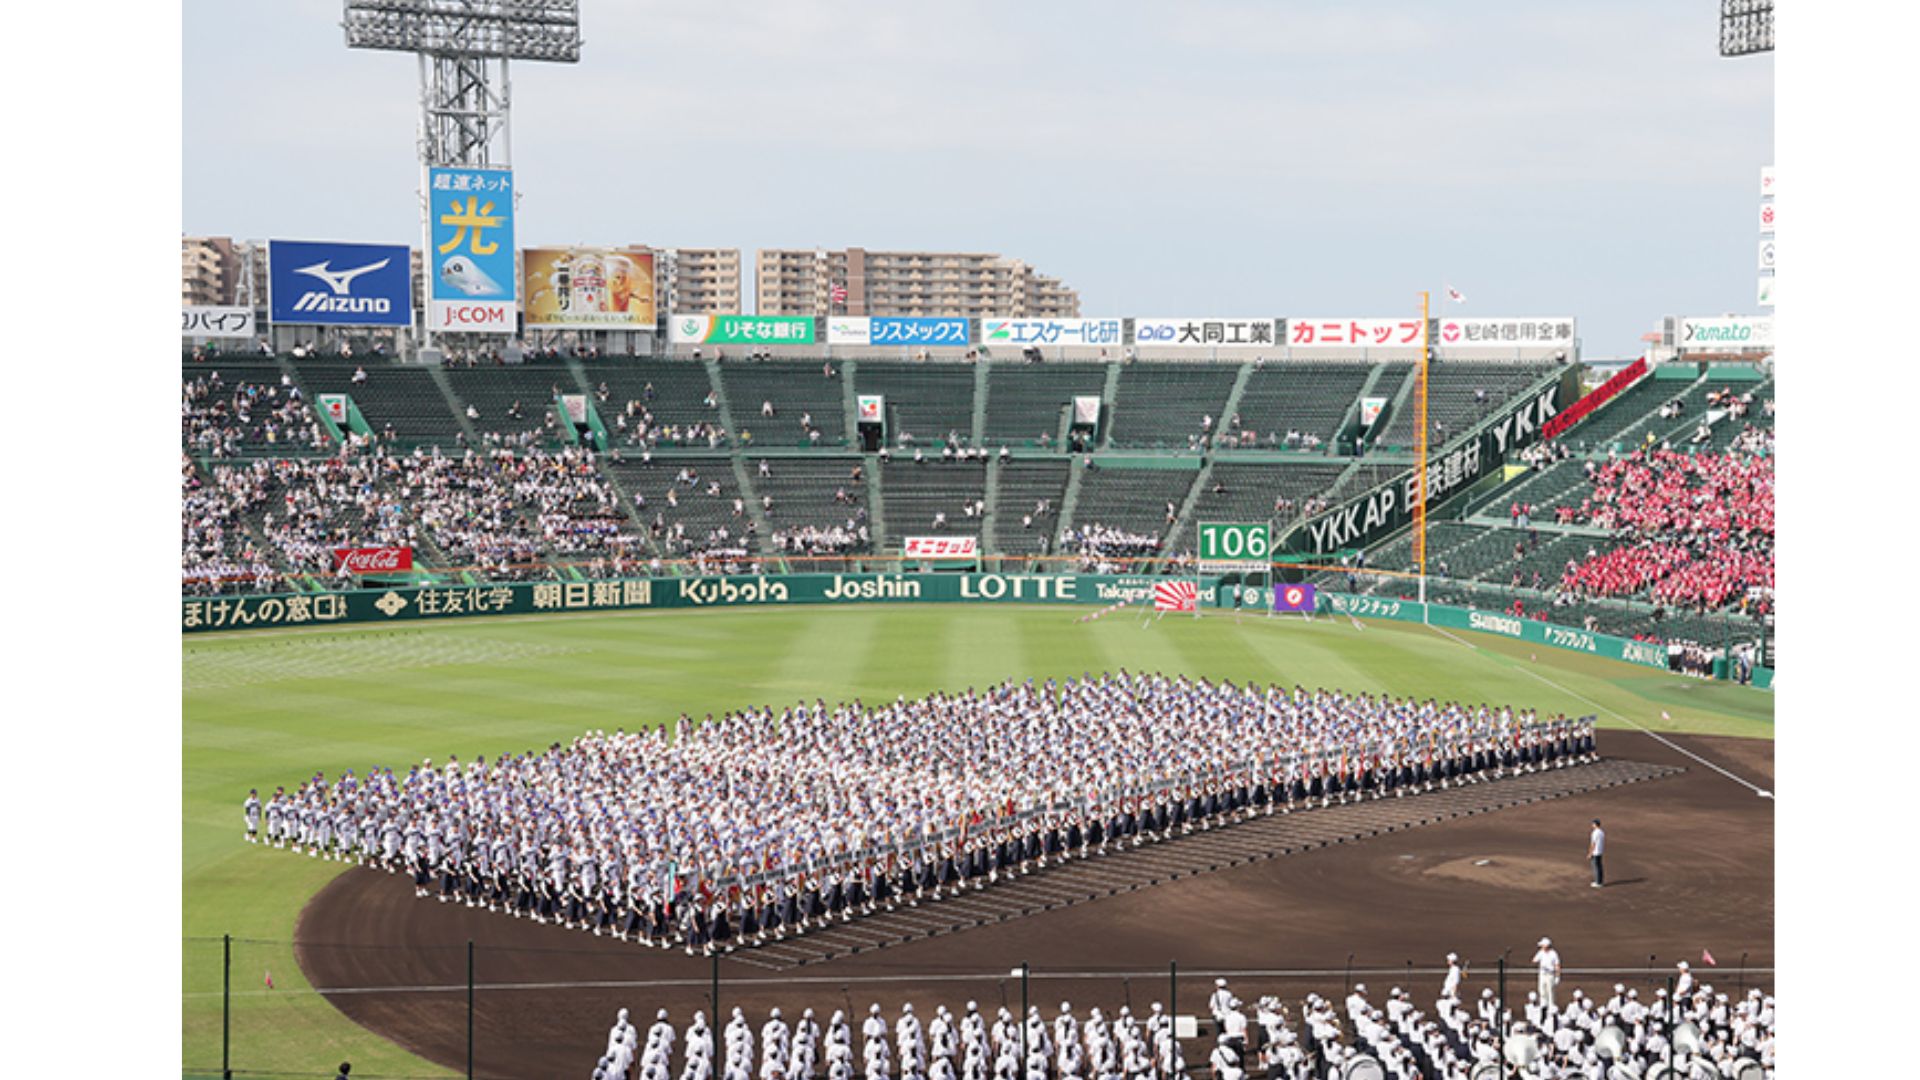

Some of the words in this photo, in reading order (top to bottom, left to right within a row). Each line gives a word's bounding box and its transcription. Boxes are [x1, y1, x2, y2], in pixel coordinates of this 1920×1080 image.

[433, 174, 509, 191] 超速ネット
[439, 195, 508, 255] 光
[293, 292, 390, 313] MIZUNO
[445, 306, 504, 326] J:COM
[725, 322, 806, 339] りそな銀行
[872, 321, 966, 341] シスメックス
[1011, 320, 1119, 343] エスケー化研
[1179, 321, 1273, 344] 大同工業
[1292, 320, 1422, 344] カニトップ
[1464, 322, 1572, 341] 尼崎信用金庫
[1684, 324, 1751, 341] Yamato
[1495, 387, 1558, 453] YKK
[1404, 440, 1481, 514] 日鉄建材
[1310, 504, 1361, 555] YKK
[1363, 487, 1396, 533] AP
[1202, 527, 1267, 557] 106
[343, 549, 401, 569] Coca-Cola
[532, 581, 652, 609] 朝日新聞
[680, 577, 788, 604] Kubota
[824, 574, 920, 599] Joshin
[960, 575, 1077, 600] LOTTE
[415, 587, 513, 615] 住友化学
[1469, 613, 1522, 636] SHIMANO
